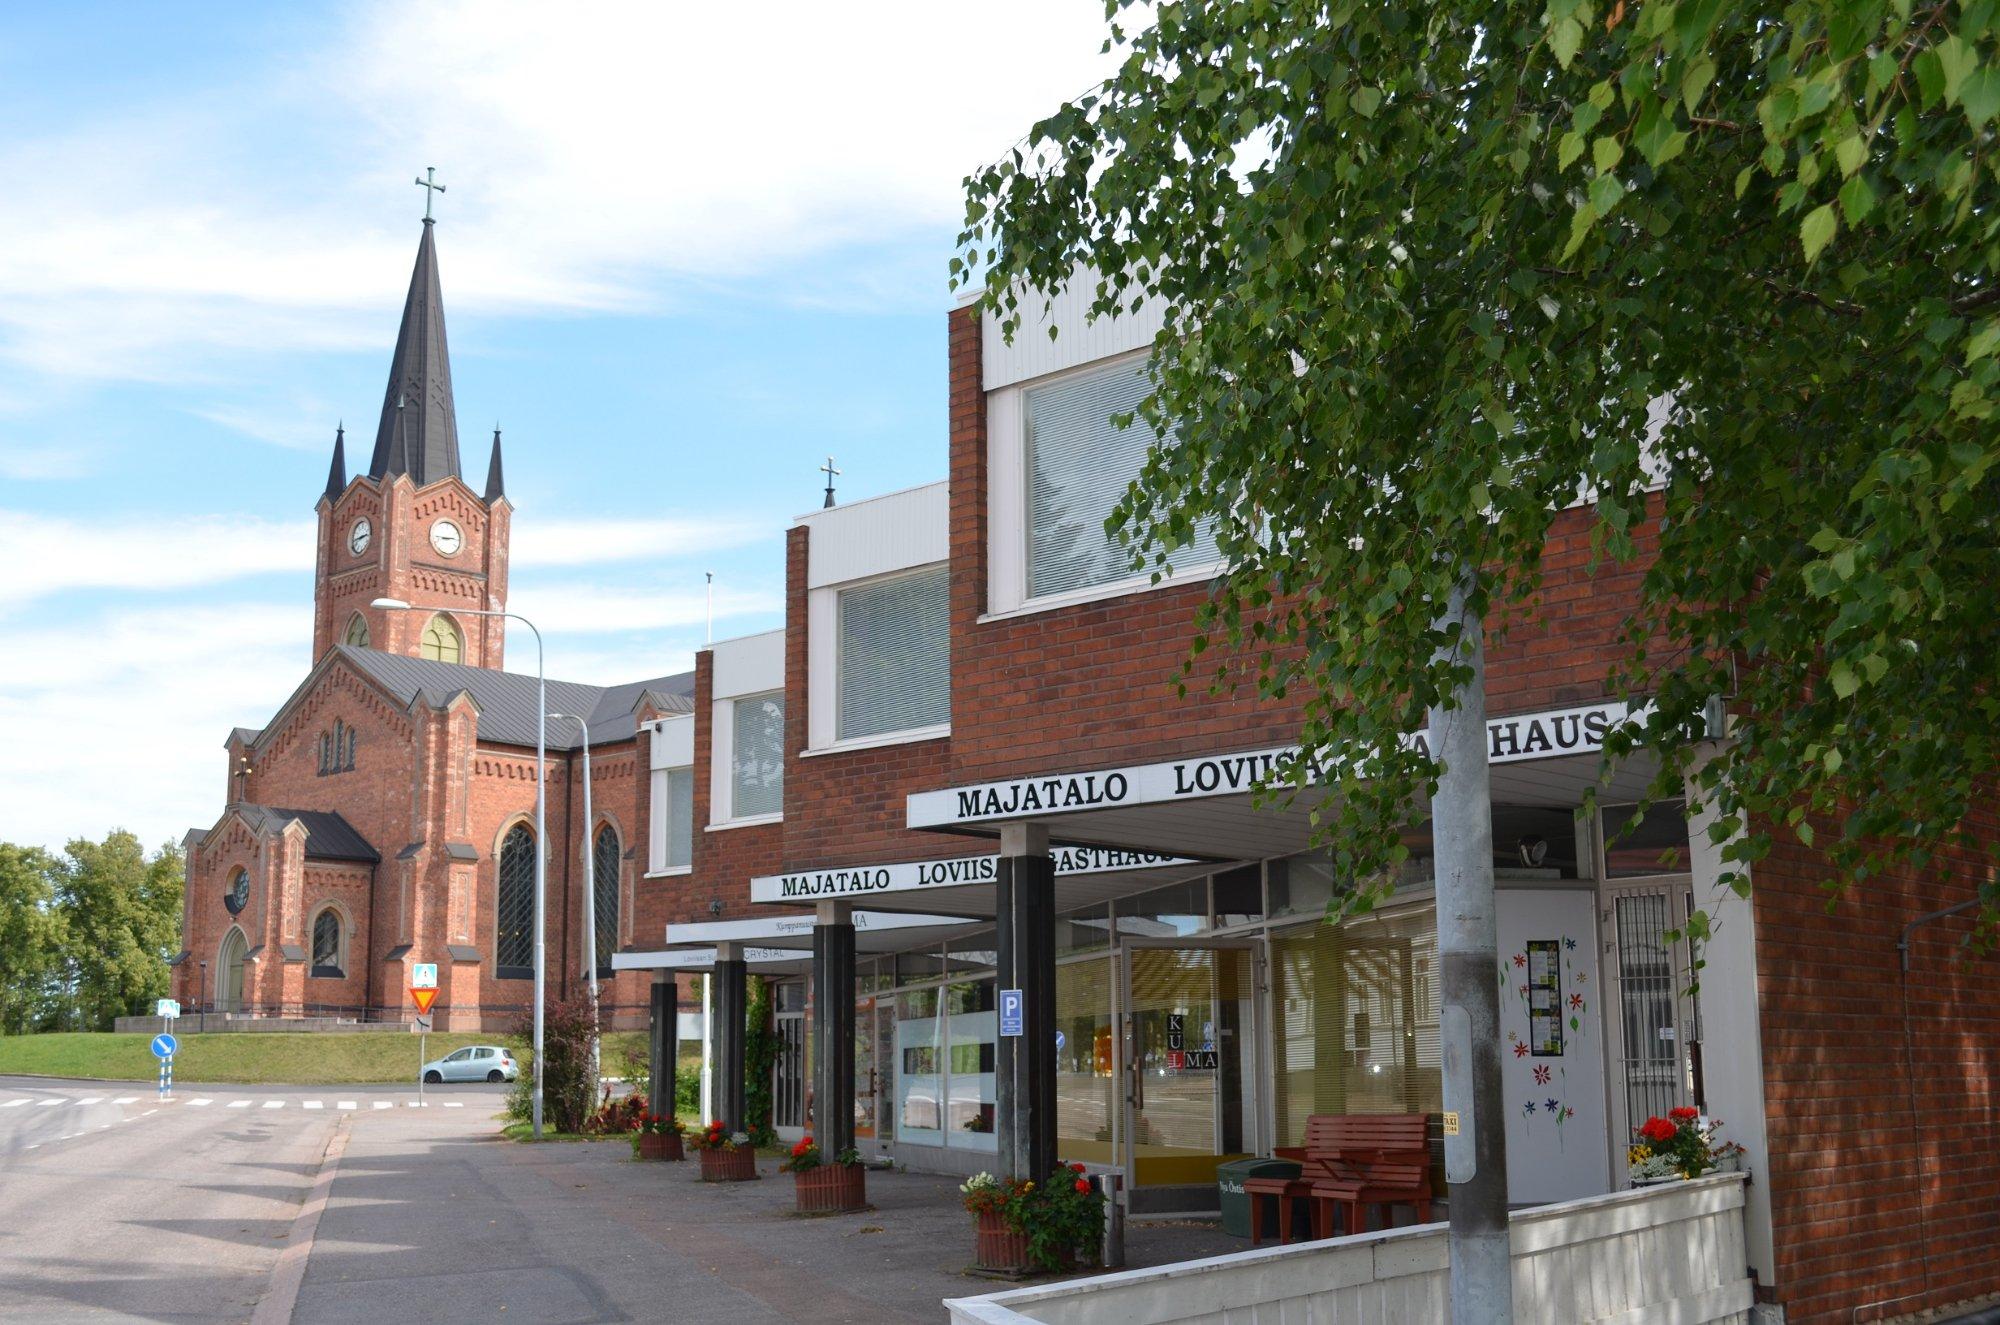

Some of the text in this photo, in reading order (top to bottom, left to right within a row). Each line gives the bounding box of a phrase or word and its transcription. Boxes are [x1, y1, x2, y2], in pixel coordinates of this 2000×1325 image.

[957, 772, 1128, 818] MAJATALO
[781, 868, 891, 897] MAJATALO
[918, 857, 997, 885] LOVIIS
[1006, 996, 1018, 1017] P
